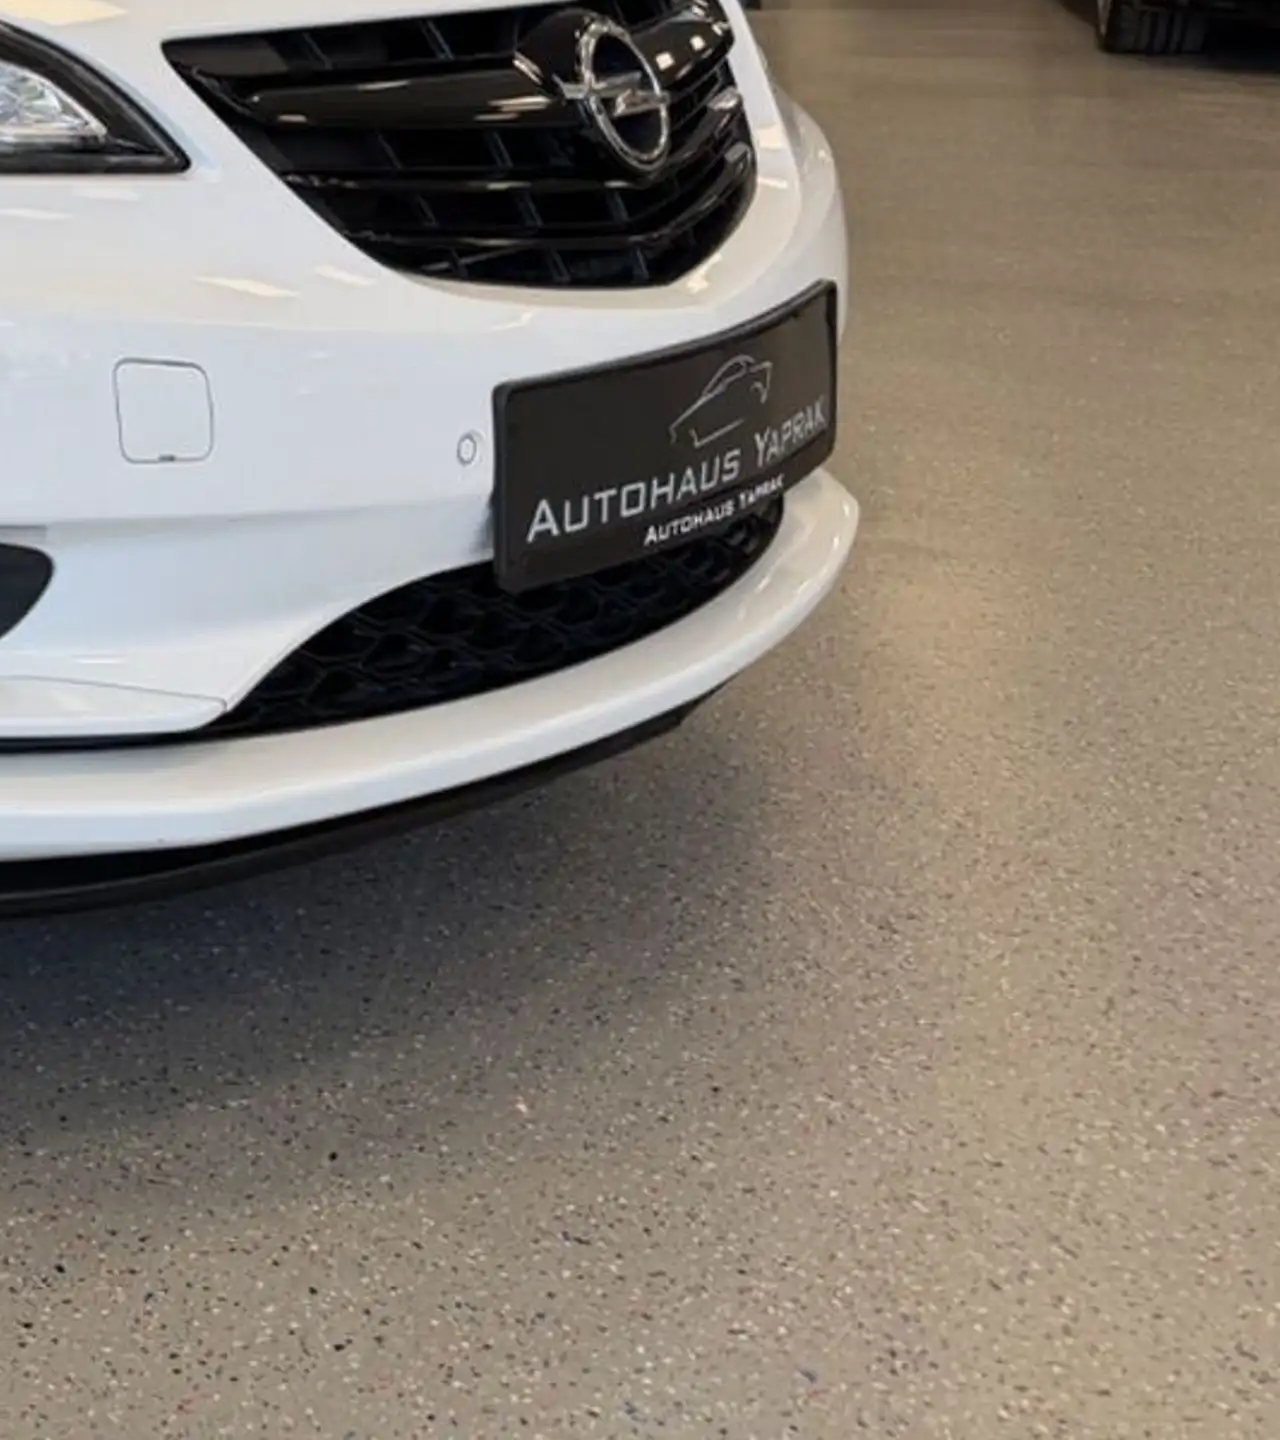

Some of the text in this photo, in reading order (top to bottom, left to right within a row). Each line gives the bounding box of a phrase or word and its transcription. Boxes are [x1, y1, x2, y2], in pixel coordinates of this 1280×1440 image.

[526, 394, 827, 544] AUTOHAUS YAPRAK
[644, 499, 735, 547] AUTOHAUS
